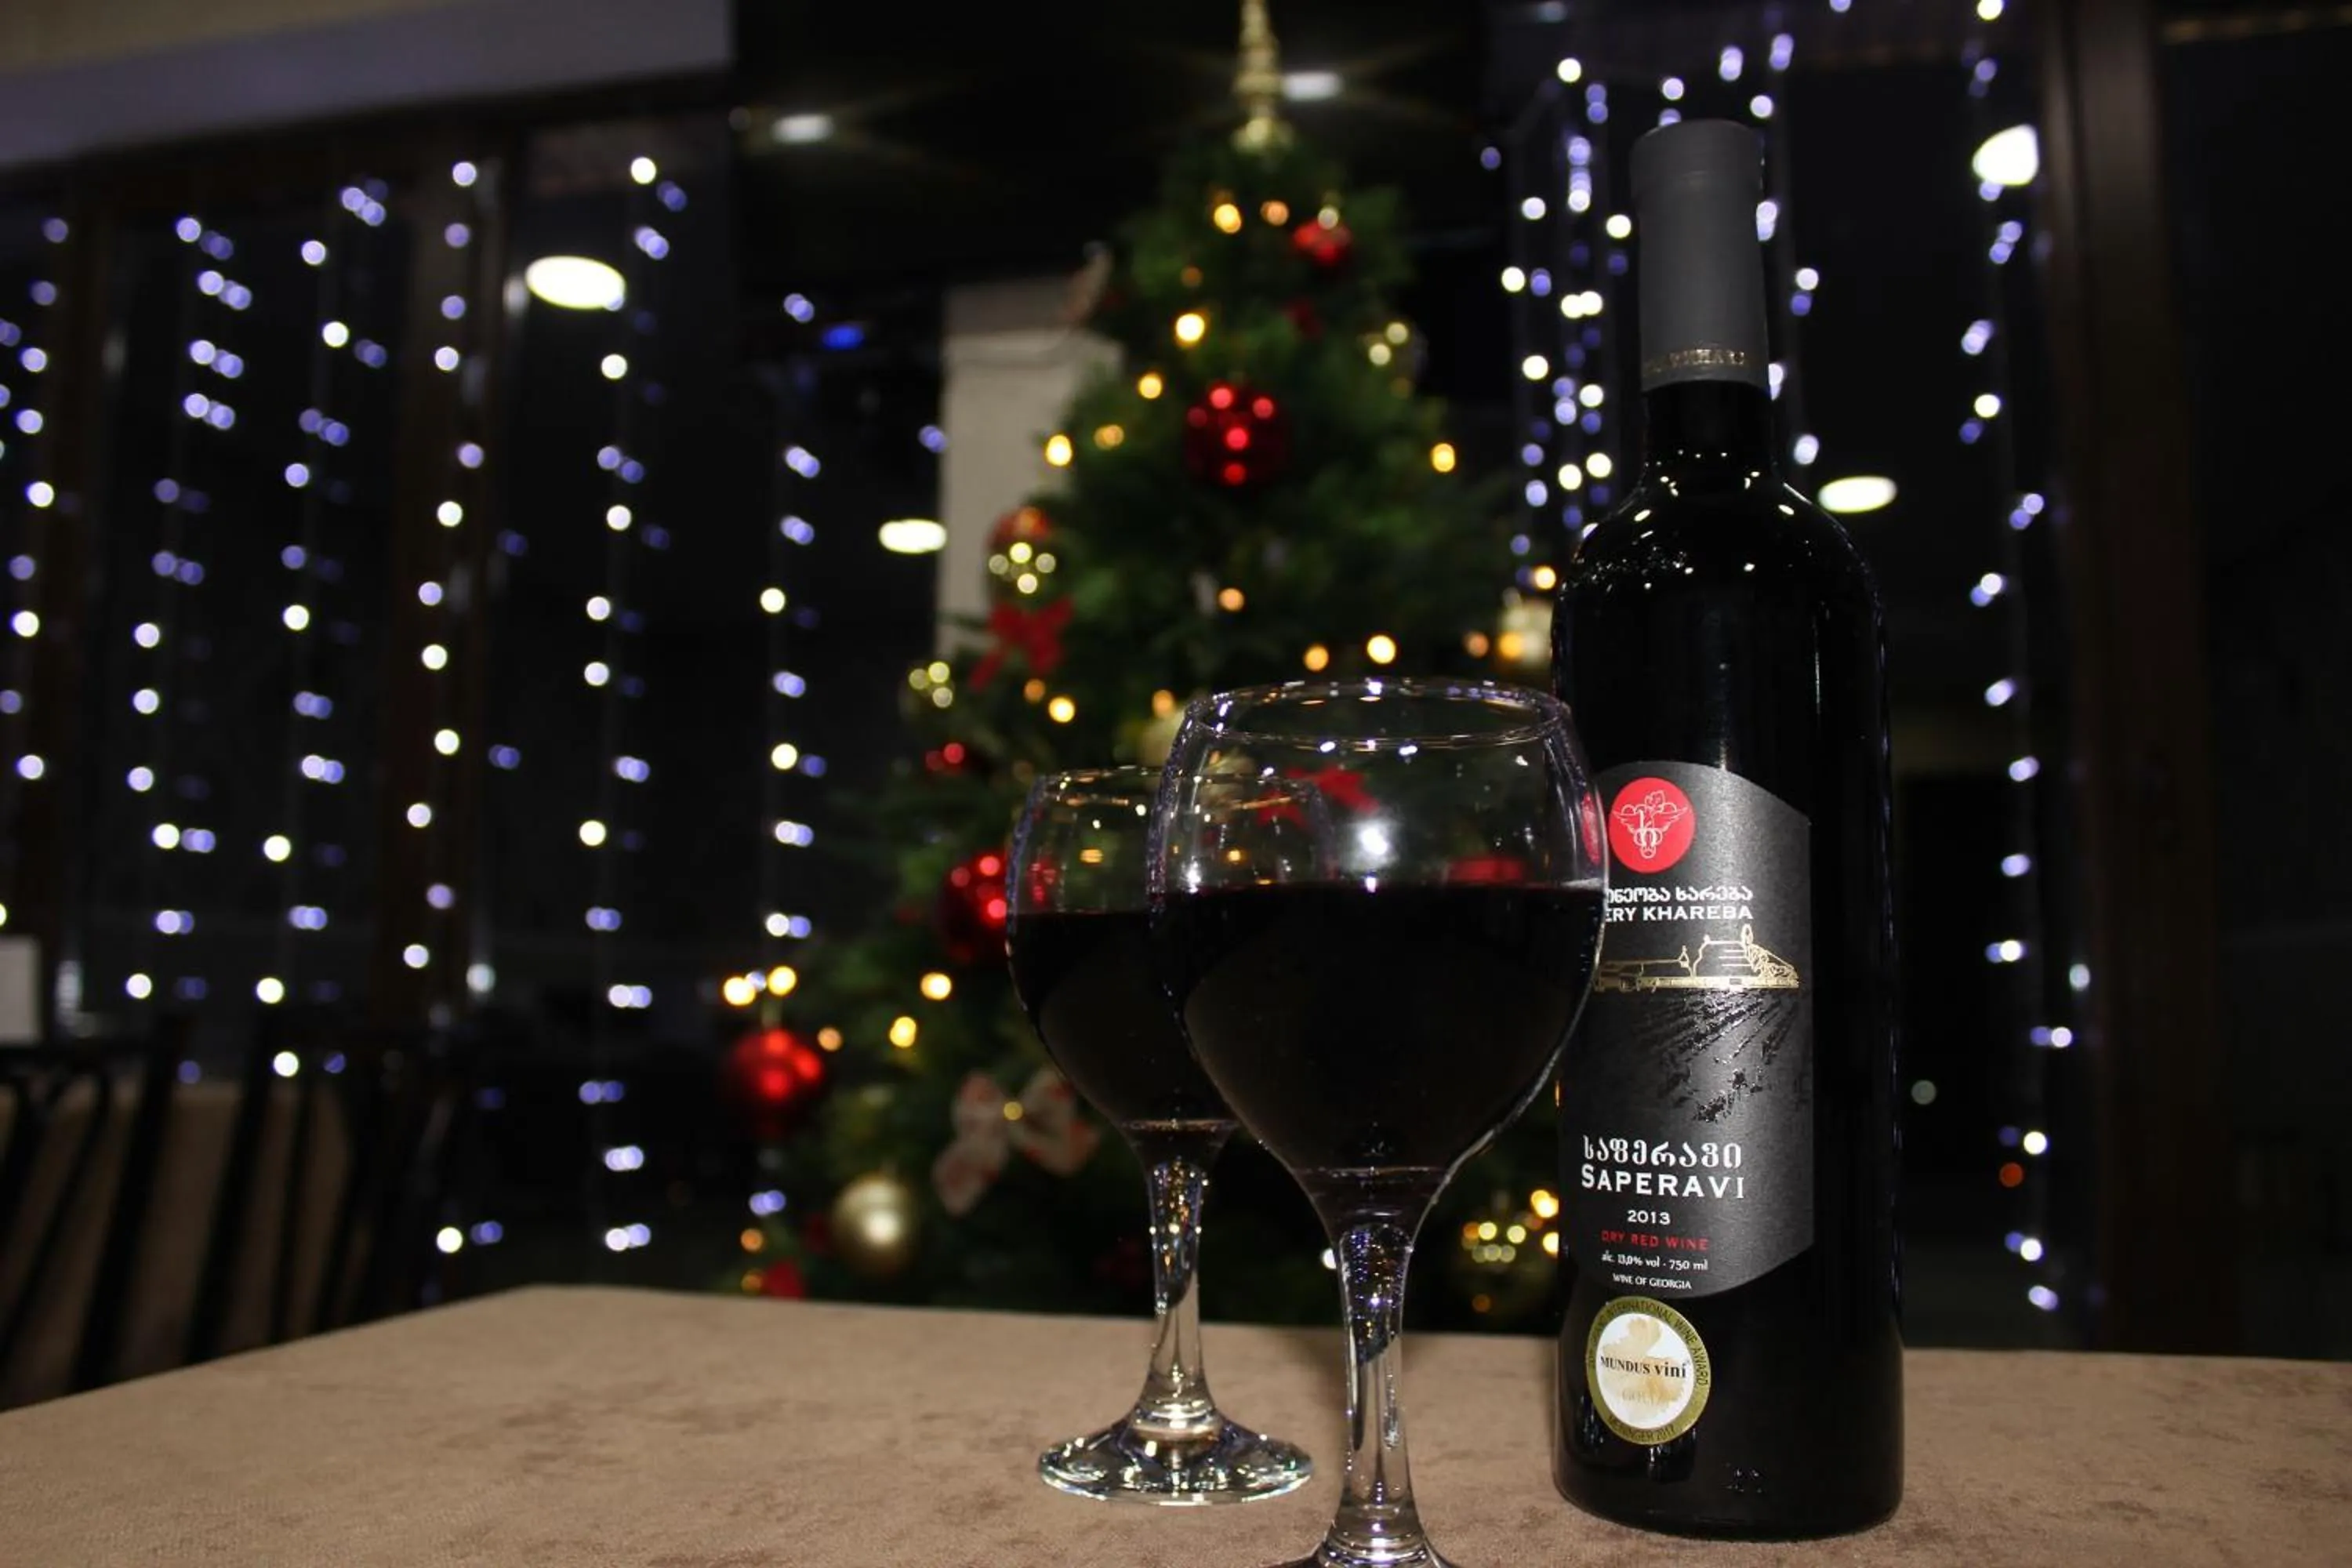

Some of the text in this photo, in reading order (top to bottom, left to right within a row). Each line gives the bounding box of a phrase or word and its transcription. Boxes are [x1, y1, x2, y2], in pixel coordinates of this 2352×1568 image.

[1675, 885, 1753, 901] ხარება
[1642, 905, 1754, 920] KHAREBA
[1582, 1134, 1742, 1169] საფერავი
[1581, 1163, 1744, 1199] SAPERAVI
[1627, 1210, 1671, 1225] 2013
[1601, 1230, 1710, 1251] DRY RED WINE
[1645, 1256, 1661, 1268] vol
[1668, 1258, 1690, 1271] 750
[1693, 1259, 1709, 1270] ml
[1612, 1272, 1693, 1290] WINE OF GEORGIA
[1675, 1318, 1696, 1344] WINE
[1691, 1347, 1710, 1387] AWARD
[1600, 1355, 1651, 1375] MUNDUS
[1653, 1361, 1686, 1379] vini
